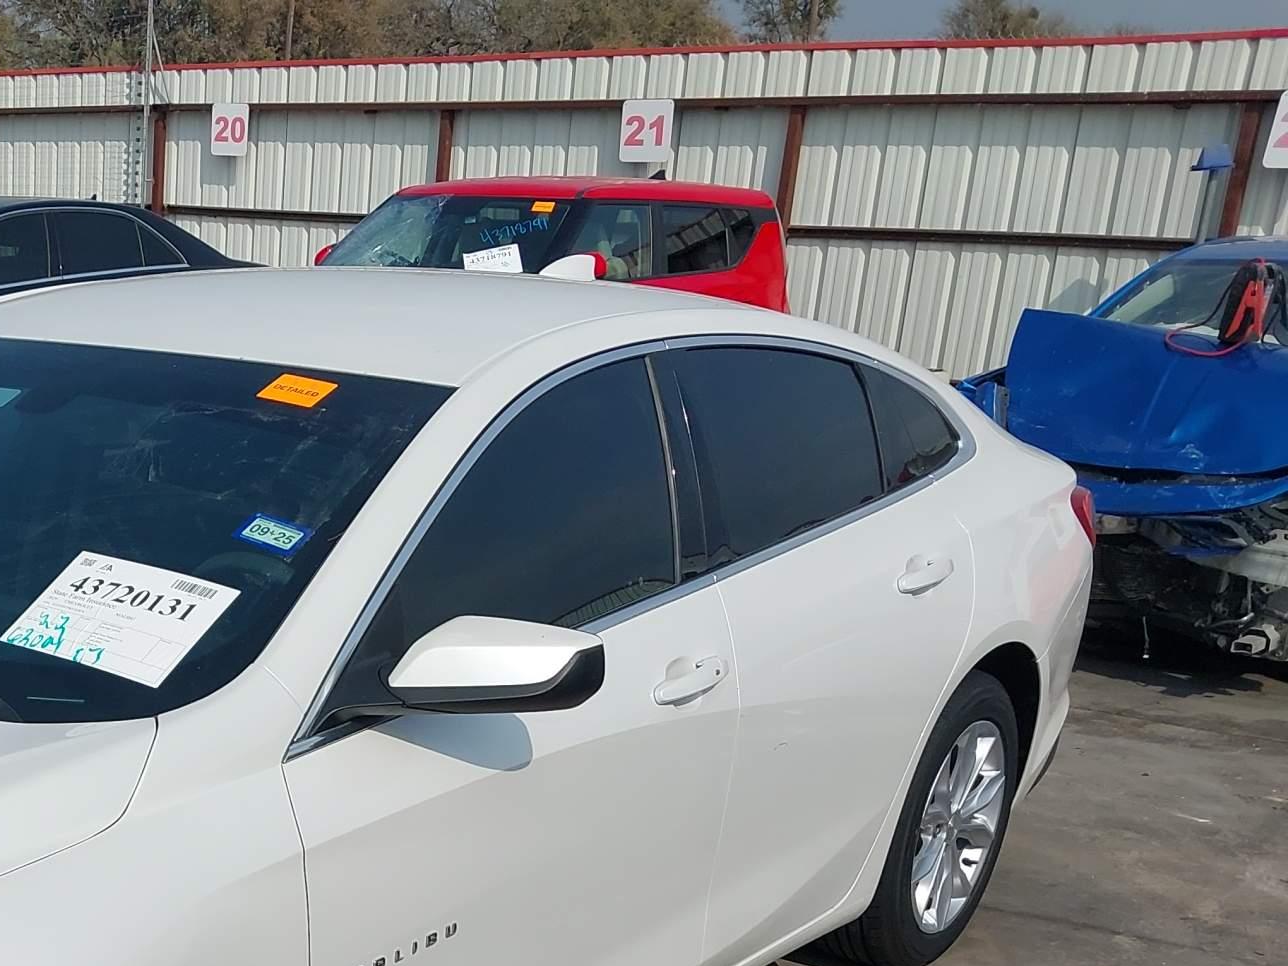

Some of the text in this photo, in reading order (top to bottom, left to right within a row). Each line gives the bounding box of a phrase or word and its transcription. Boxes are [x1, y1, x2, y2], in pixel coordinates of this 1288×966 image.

[214, 115, 246, 144] 20
[623, 114, 665, 147] 21
[273, 382, 320, 398] DETAILED
[68, 575, 199, 623] 43720131
